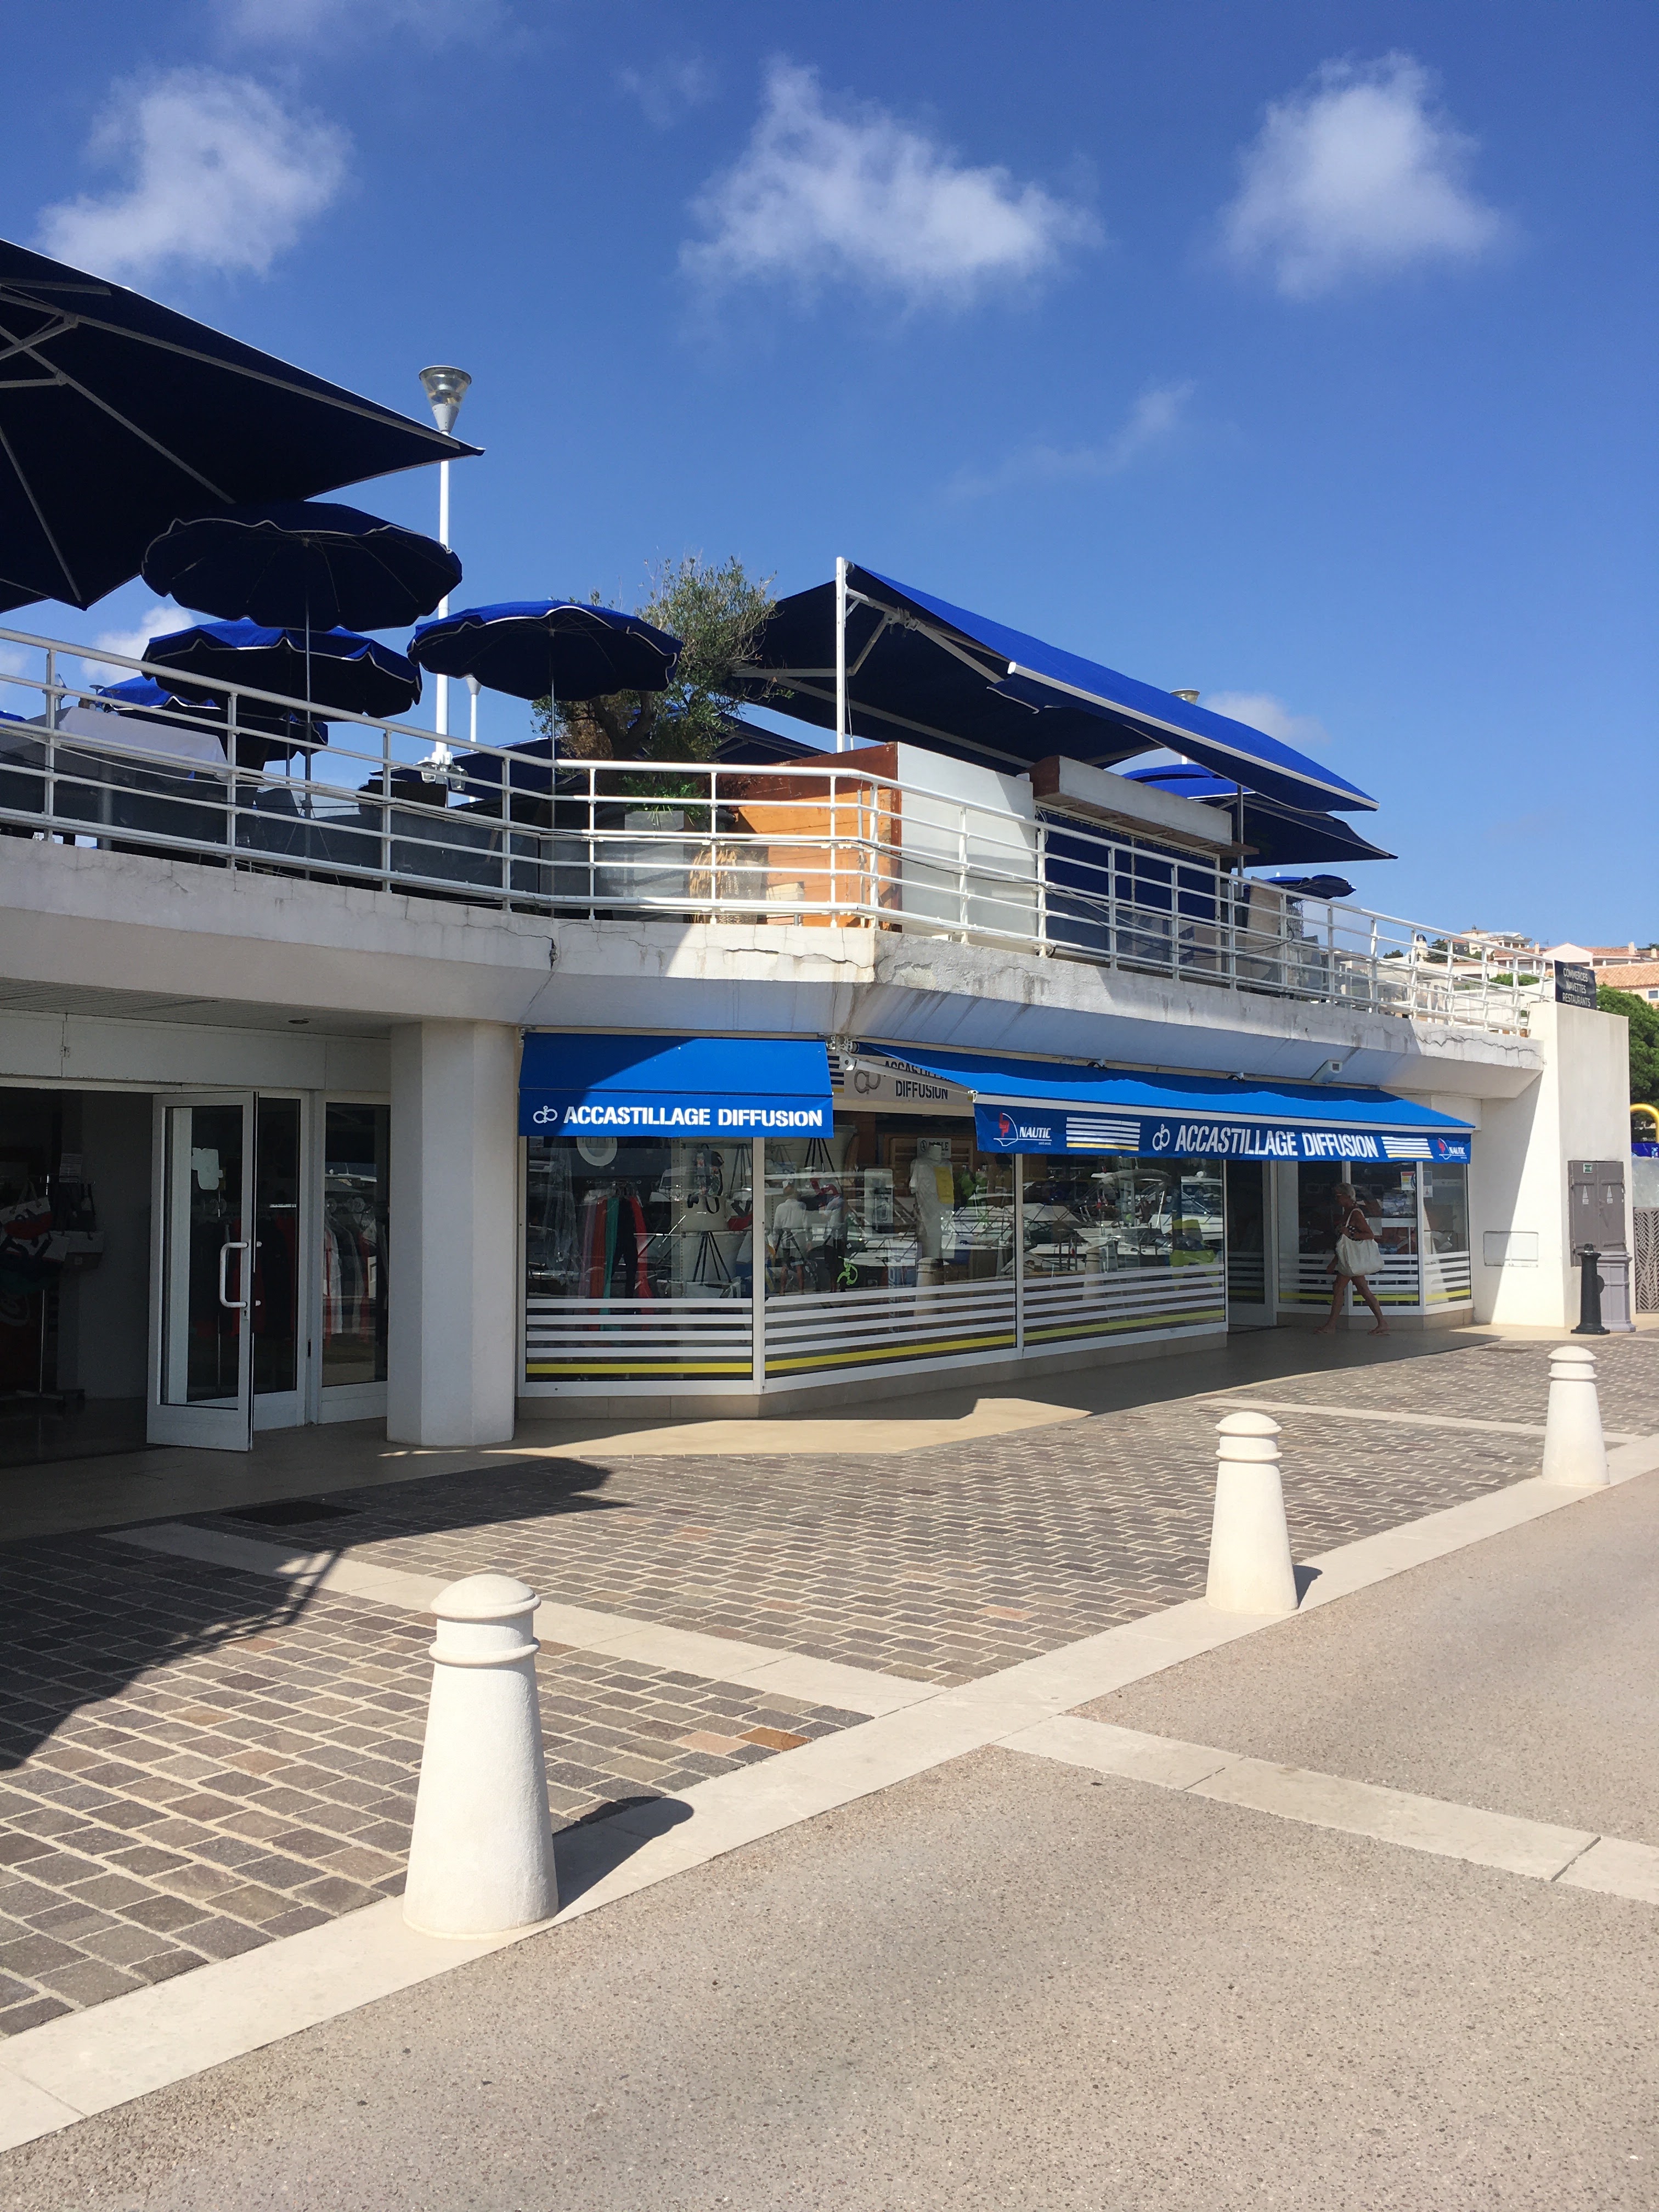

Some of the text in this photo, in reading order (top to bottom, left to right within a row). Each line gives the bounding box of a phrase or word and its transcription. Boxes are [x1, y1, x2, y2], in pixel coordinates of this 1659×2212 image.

[1563, 968, 1588, 982] COMMERCES
[1566, 980, 1587, 994] NAVETTES
[1562, 992, 1591, 1007] RESTAURANTS
[563, 1106, 822, 1127] ACCASTILLAGE DIFFUSION
[1019, 1126, 1051, 1138] NAUTIC
[1175, 1125, 1379, 1158] ACCASTILLAGE DIFFUSION
